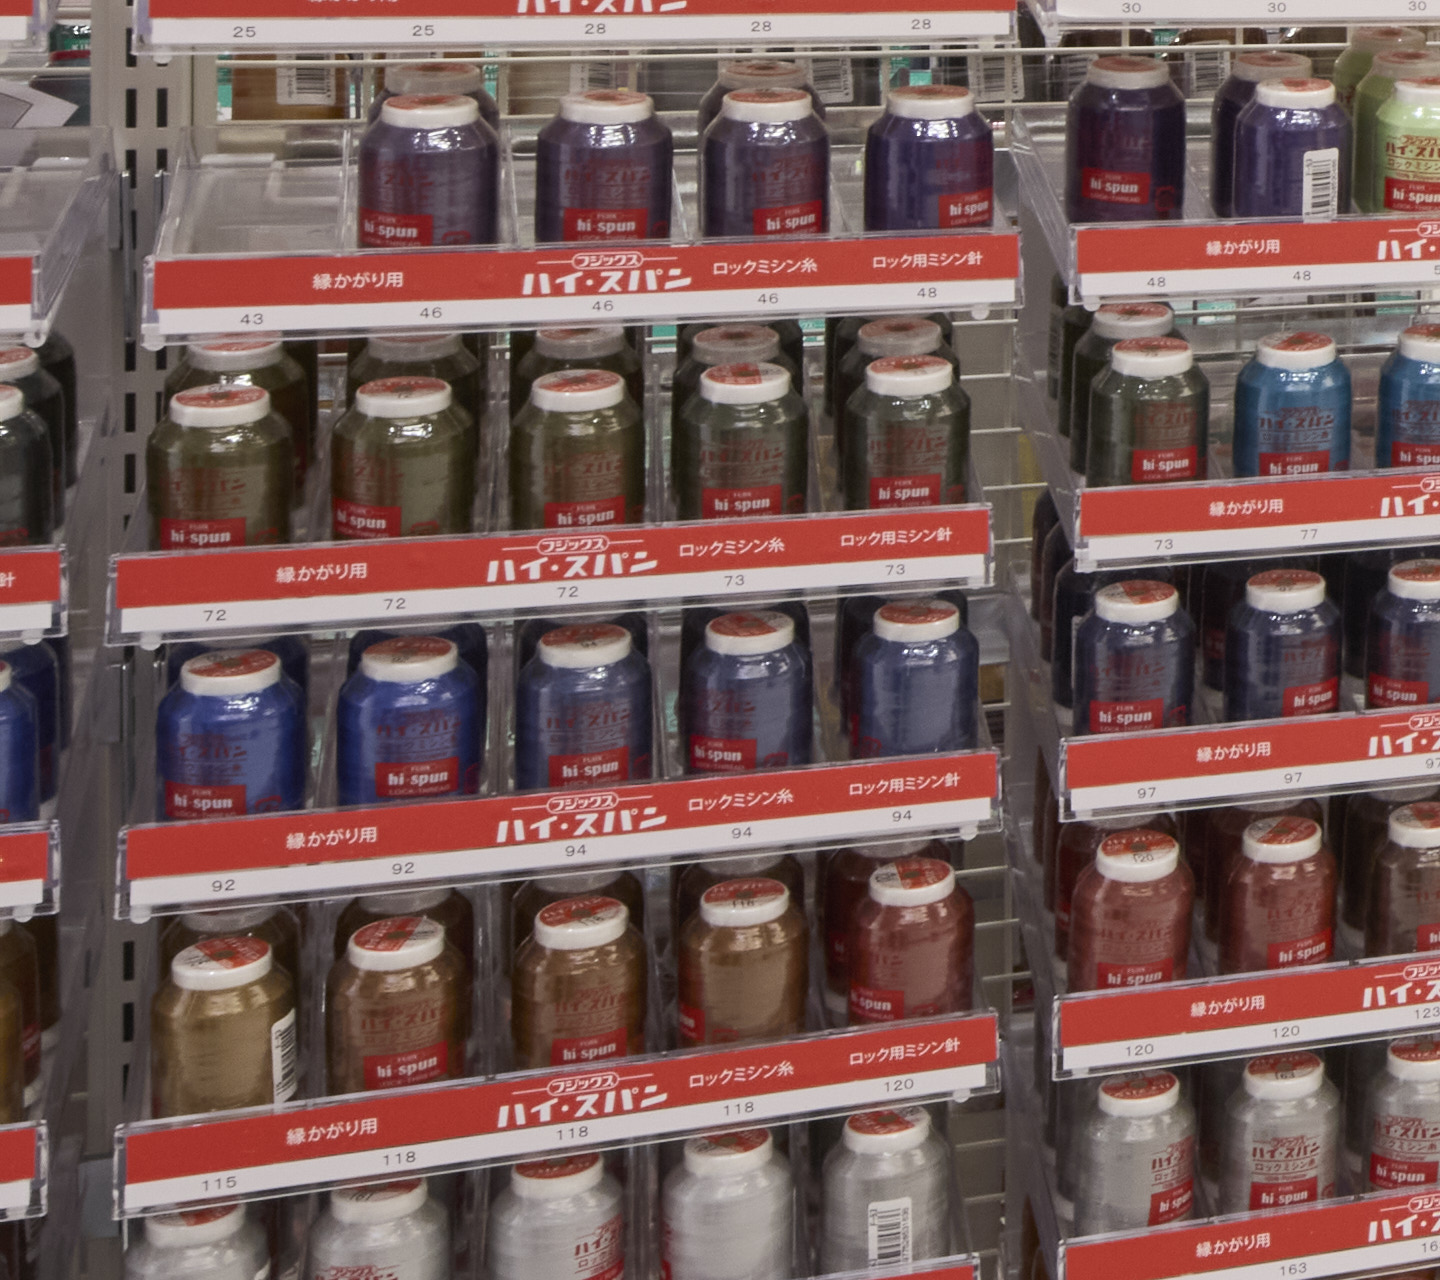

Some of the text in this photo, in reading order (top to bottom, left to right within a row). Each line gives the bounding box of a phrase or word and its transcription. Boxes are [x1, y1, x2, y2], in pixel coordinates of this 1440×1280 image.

[1122, 3, 1141, 13] 30
[313, 251, 983, 295] 縁かがり用 ハイ・スパン ロックミシン糸 ロック用ミシン針
[240, 286, 938, 325] 43 46 46 48
[1210, 499, 1283, 516] 縁かがり用
[1155, 539, 1173, 550] 73
[1301, 529, 1317, 539] 77
[287, 772, 960, 849] 縁かがり用 ハイ・スパン ロックミシン糸 ロック用ミシン針
[212, 810, 911, 892] 92 94 94
[1191, 995, 1265, 1016] 縁かがり用
[1126, 1044, 1154, 1056] 120
[1416, 1007, 1440, 1019] 123
